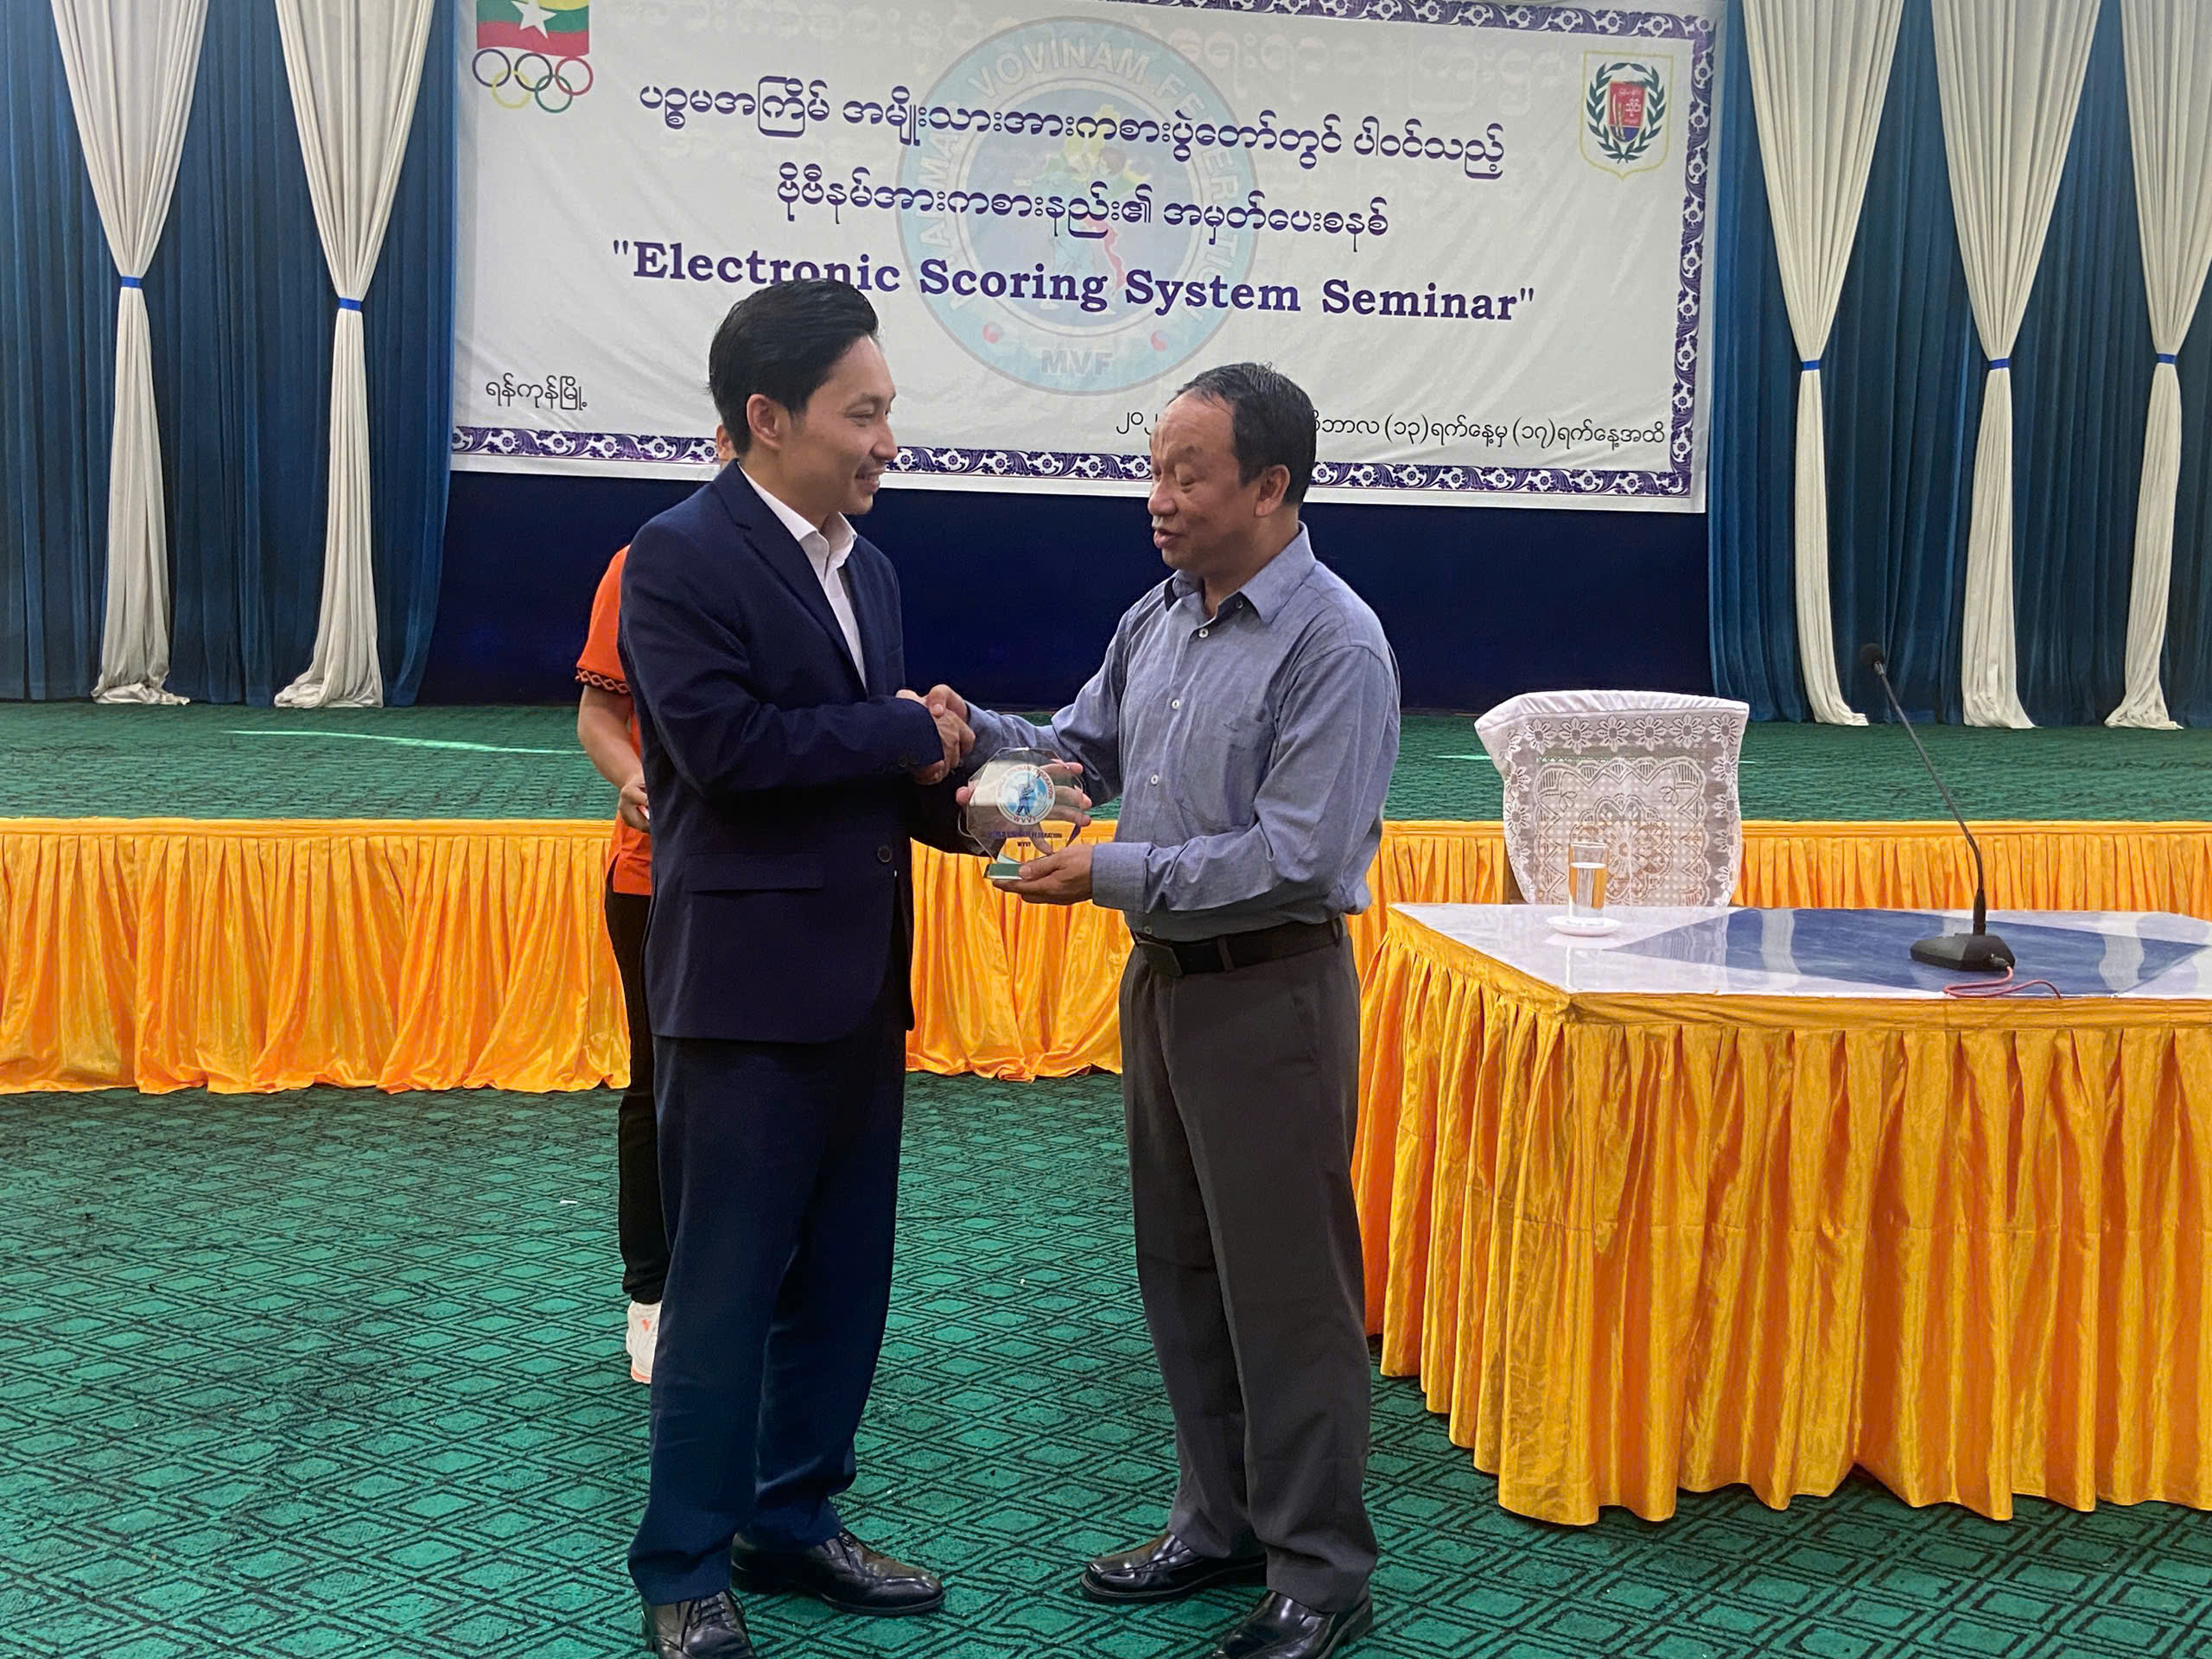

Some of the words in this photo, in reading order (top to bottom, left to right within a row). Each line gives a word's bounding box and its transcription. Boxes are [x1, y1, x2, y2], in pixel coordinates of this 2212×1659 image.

[968, 39, 1149, 98] VOVINAM
[919, 258, 1109, 313] Scoring
[1125, 269, 1301, 316] System
[1041, 348, 1114, 375] MVF
